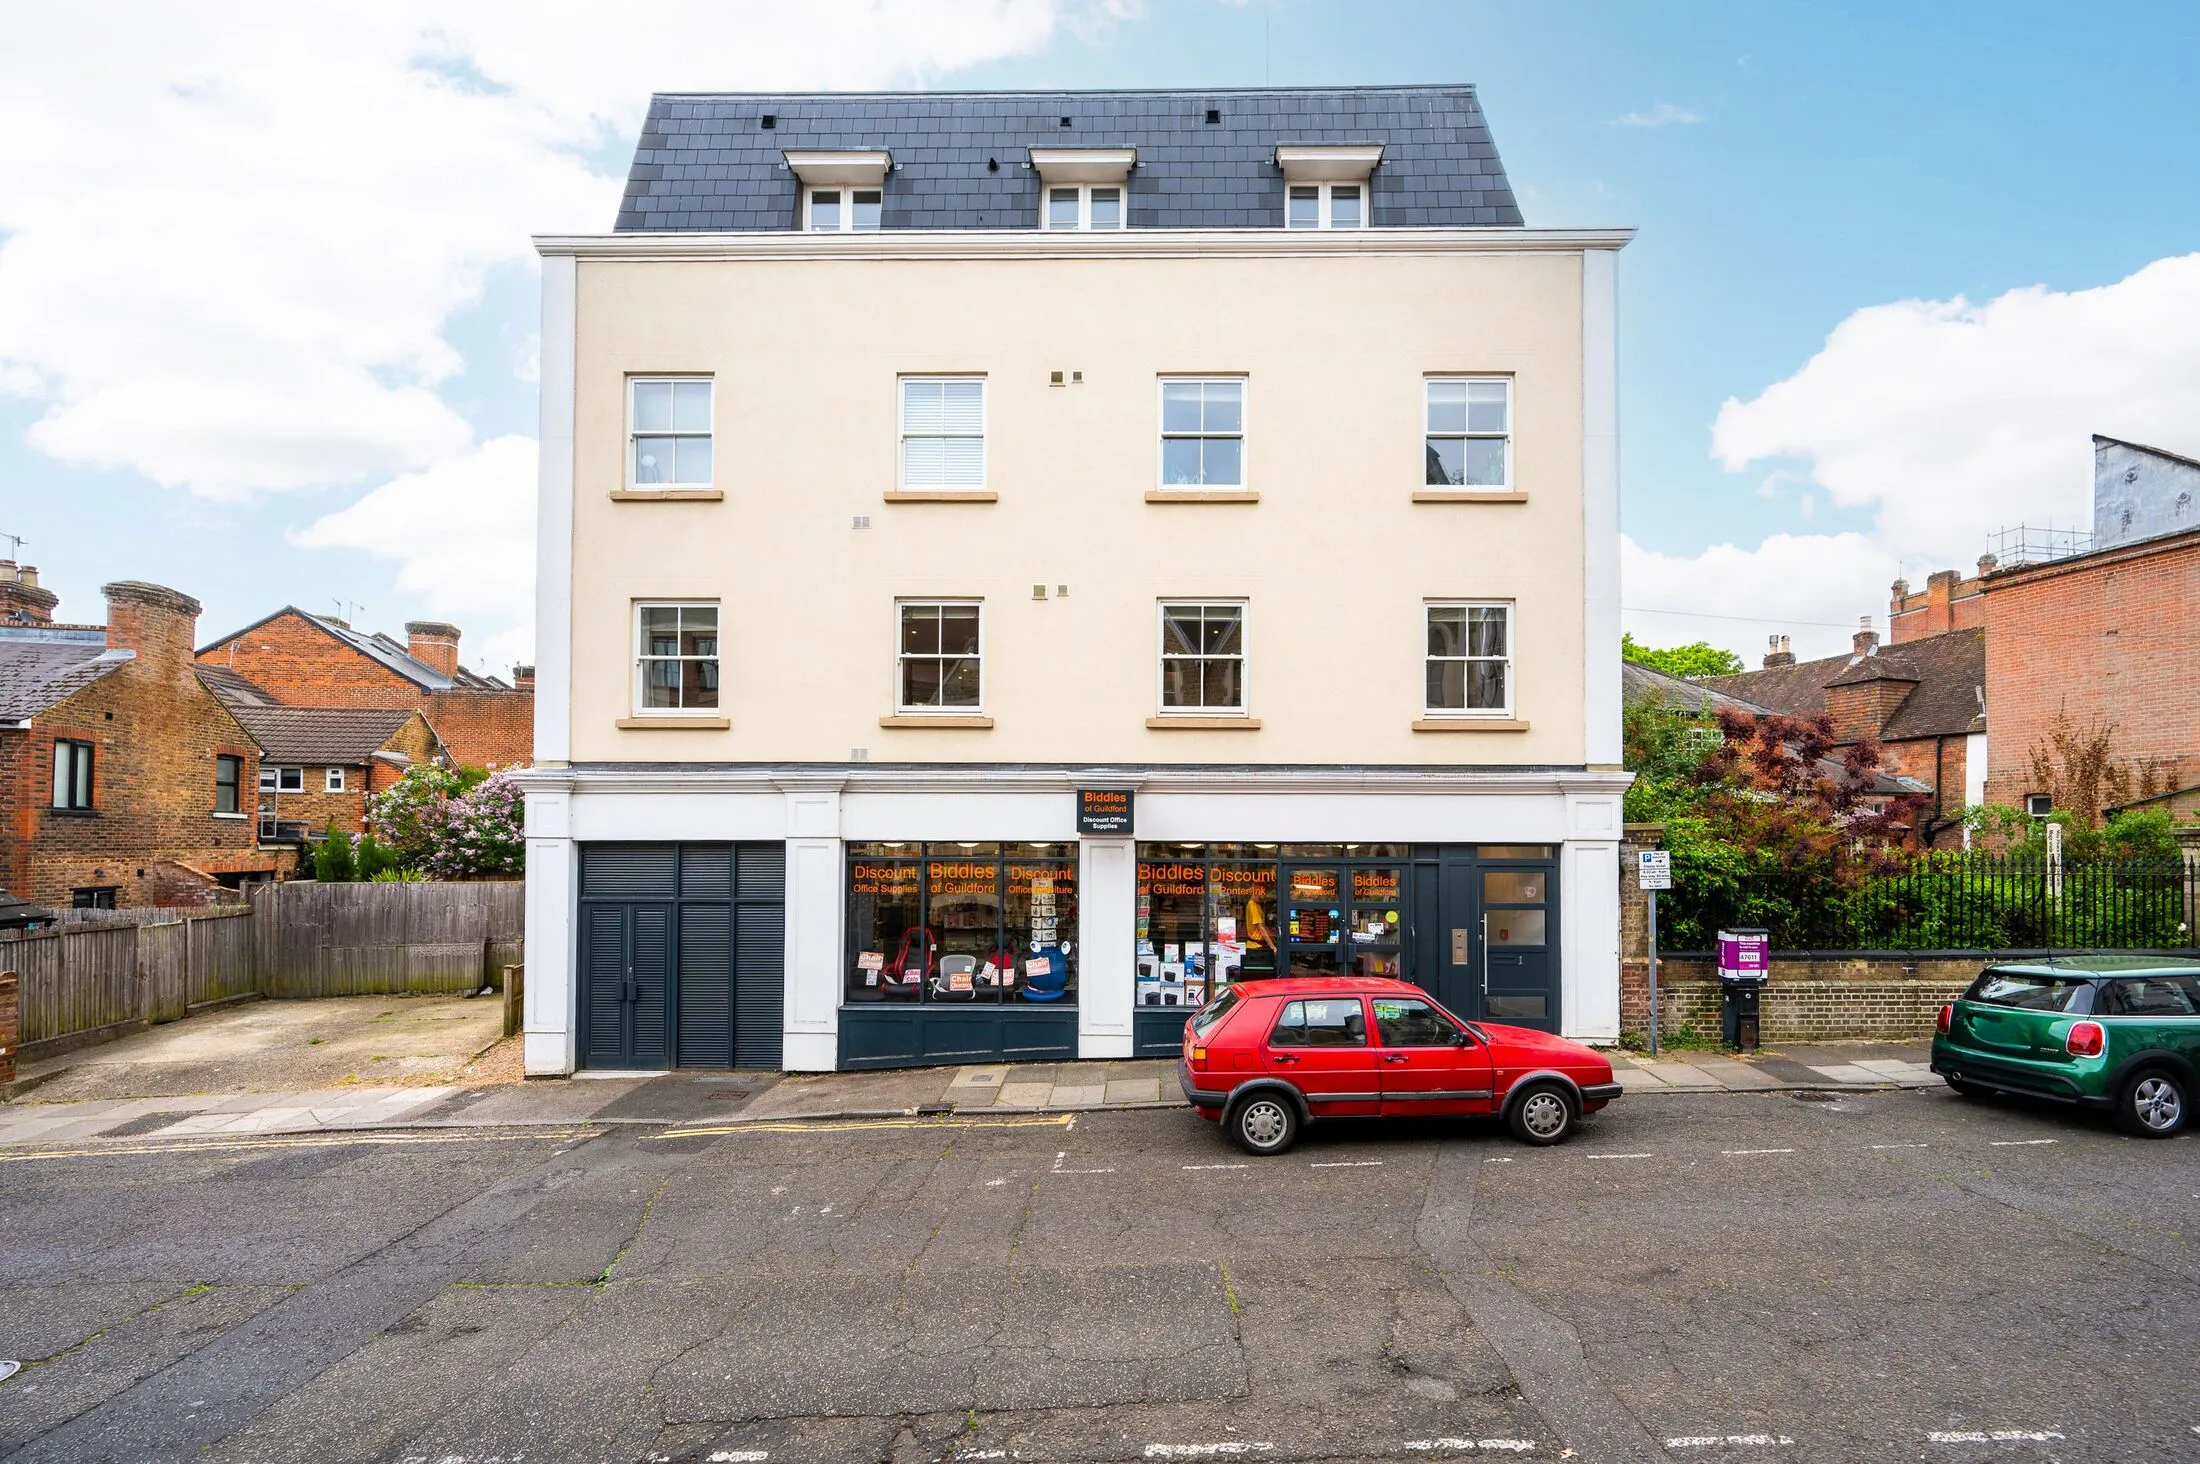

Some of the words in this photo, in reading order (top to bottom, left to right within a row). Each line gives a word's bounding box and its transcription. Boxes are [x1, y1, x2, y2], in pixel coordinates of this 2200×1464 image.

[1084, 792, 1127, 802] Biddles
[1093, 804, 1127, 812] Guildford
[855, 865, 916, 879] Discount
[930, 862, 996, 879] Biddles
[1011, 866, 1072, 880] Discount
[1139, 863, 1204, 880] Biddles
[1210, 868, 1276, 882] Discount
[1293, 875, 1335, 886] Biddles
[1354, 875, 1397, 887] Biddles
[853, 884, 879, 893] Office
[880, 884, 918, 894] Supplies
[930, 882, 942, 893] of
[944, 882, 995, 894] Guildford
[1008, 885, 1032, 894] Office
[1033, 885, 1073, 894] niture
[1139, 884, 1150, 895] of
[1153, 884, 1205, 895] Guildford
[1220, 886, 1250, 896] Printer
[1251, 886, 1266, 896] Ink
